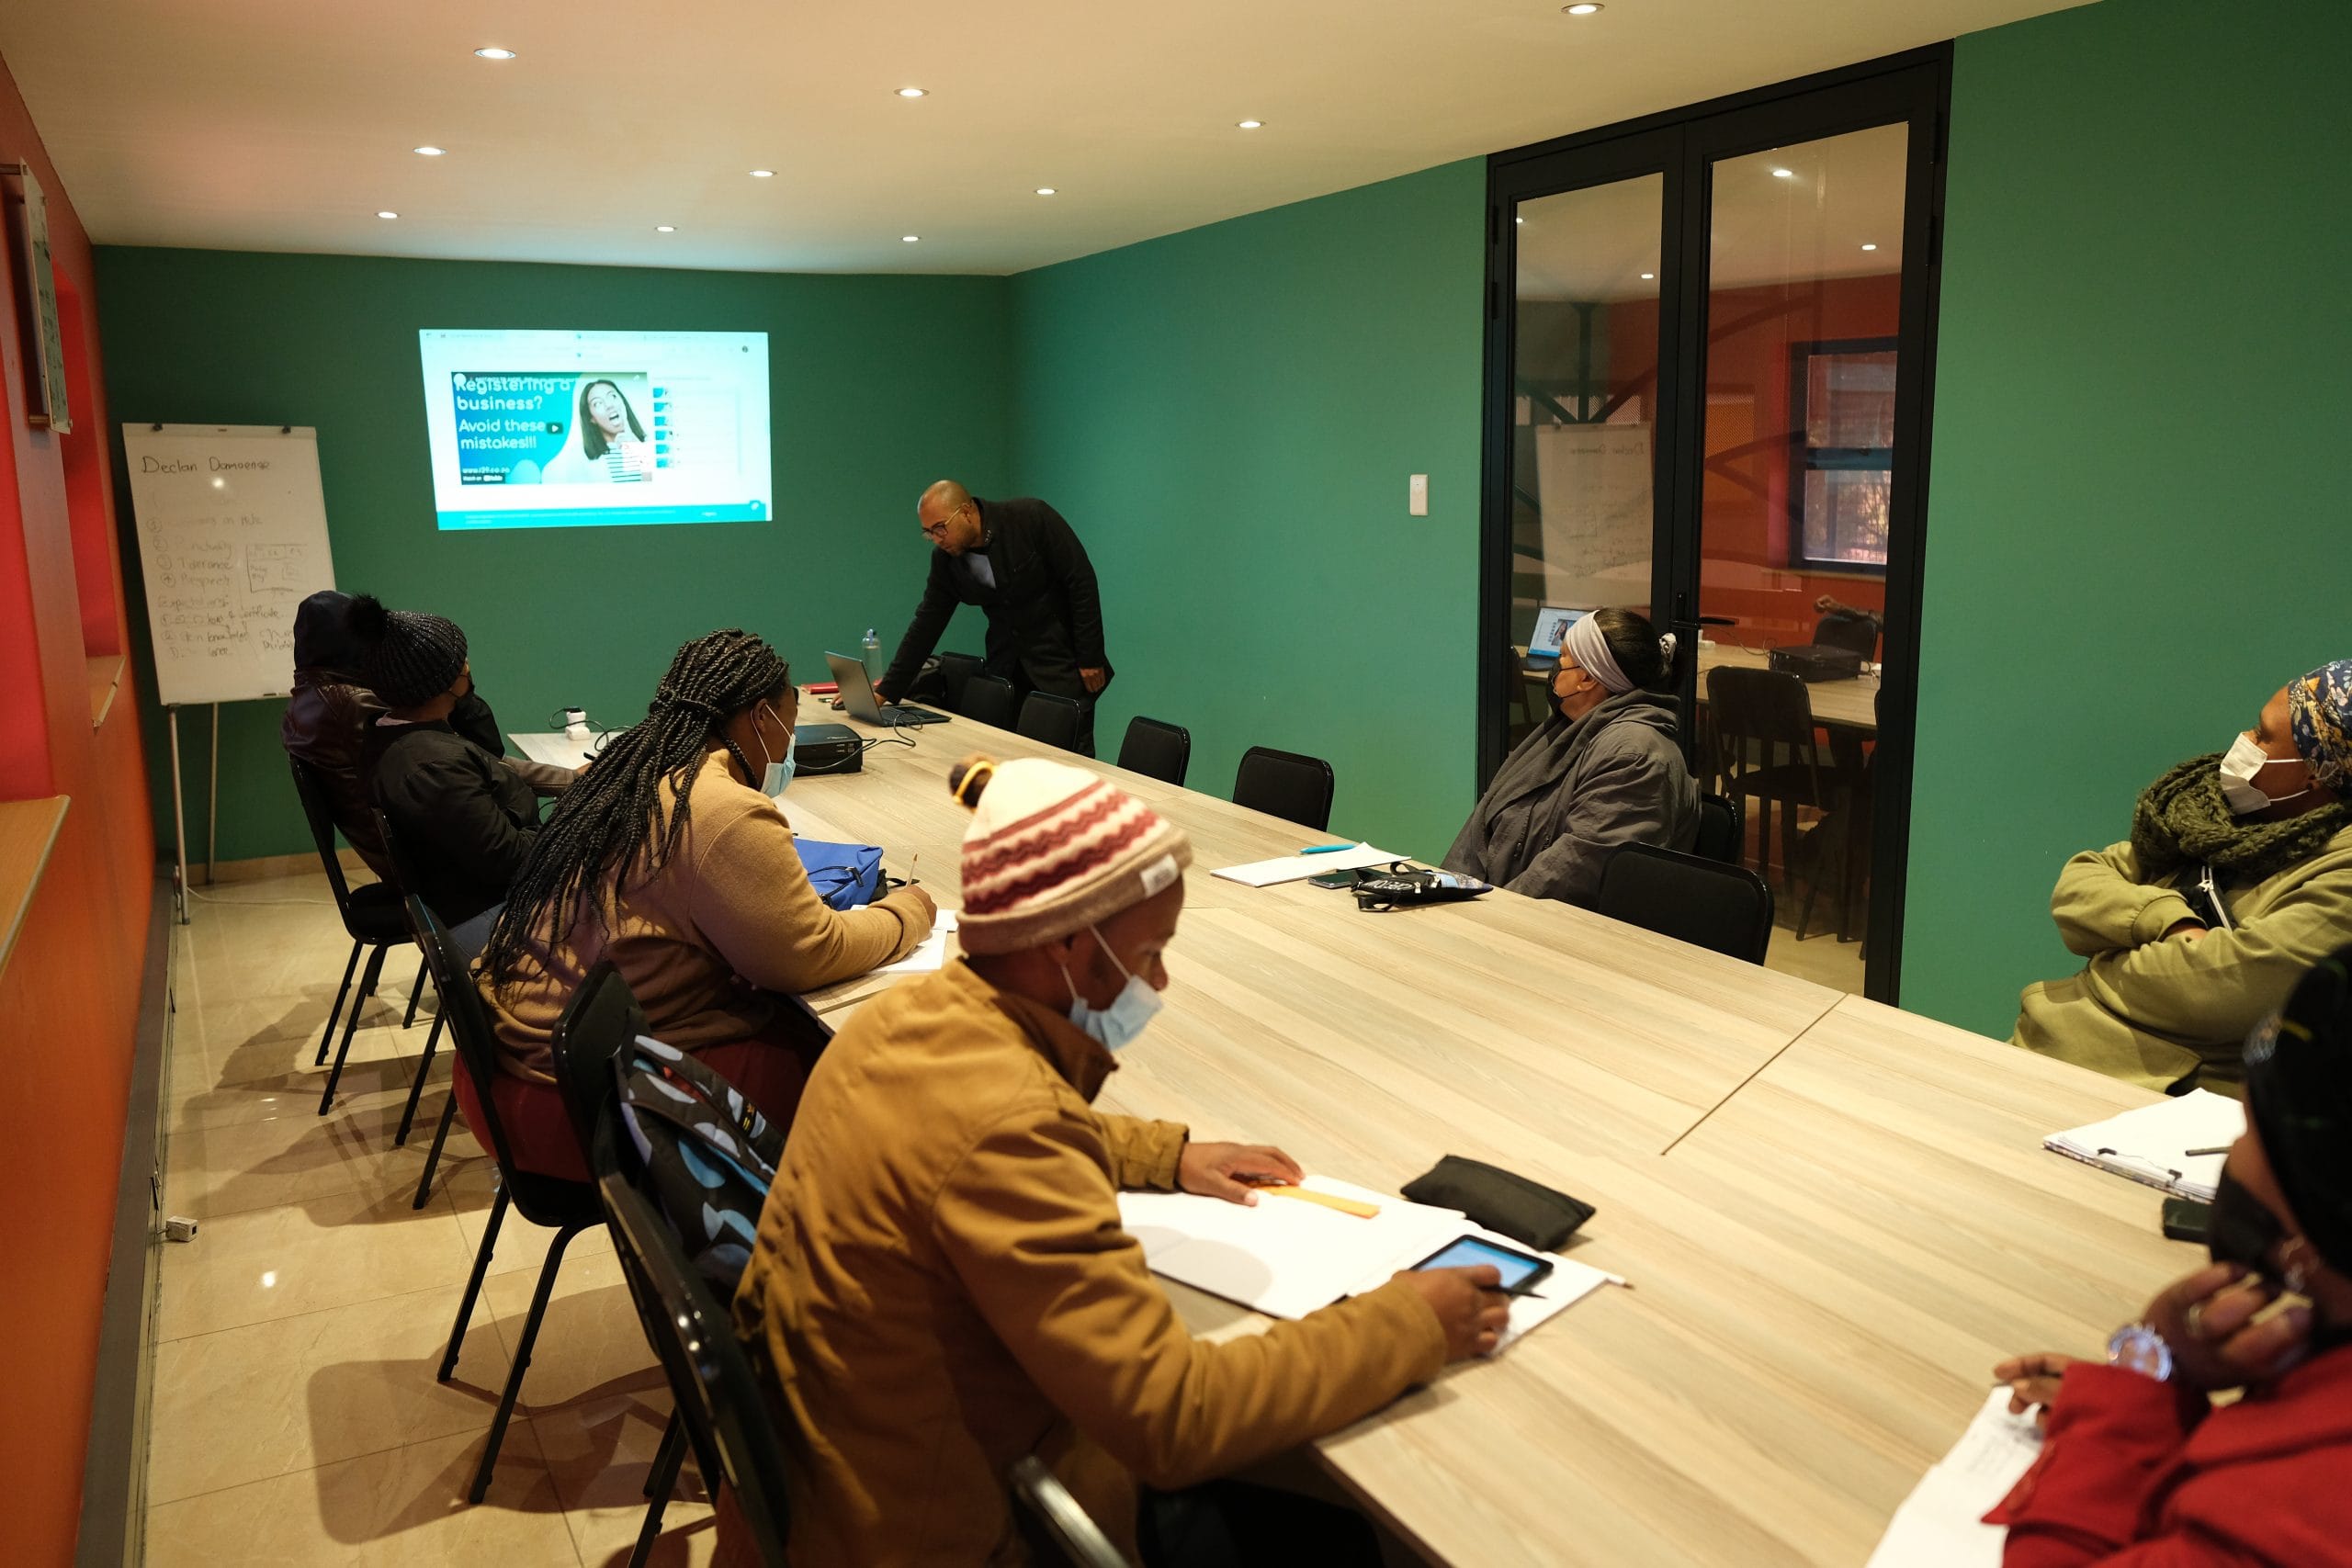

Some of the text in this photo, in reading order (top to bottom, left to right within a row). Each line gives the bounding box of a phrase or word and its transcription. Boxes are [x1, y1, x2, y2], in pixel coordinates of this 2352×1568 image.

[457, 395, 543, 411] business?
[458, 418, 546, 433] Avoid these
[460, 435, 537, 449] mistakes!!!
[142, 456, 198, 474] Declan
